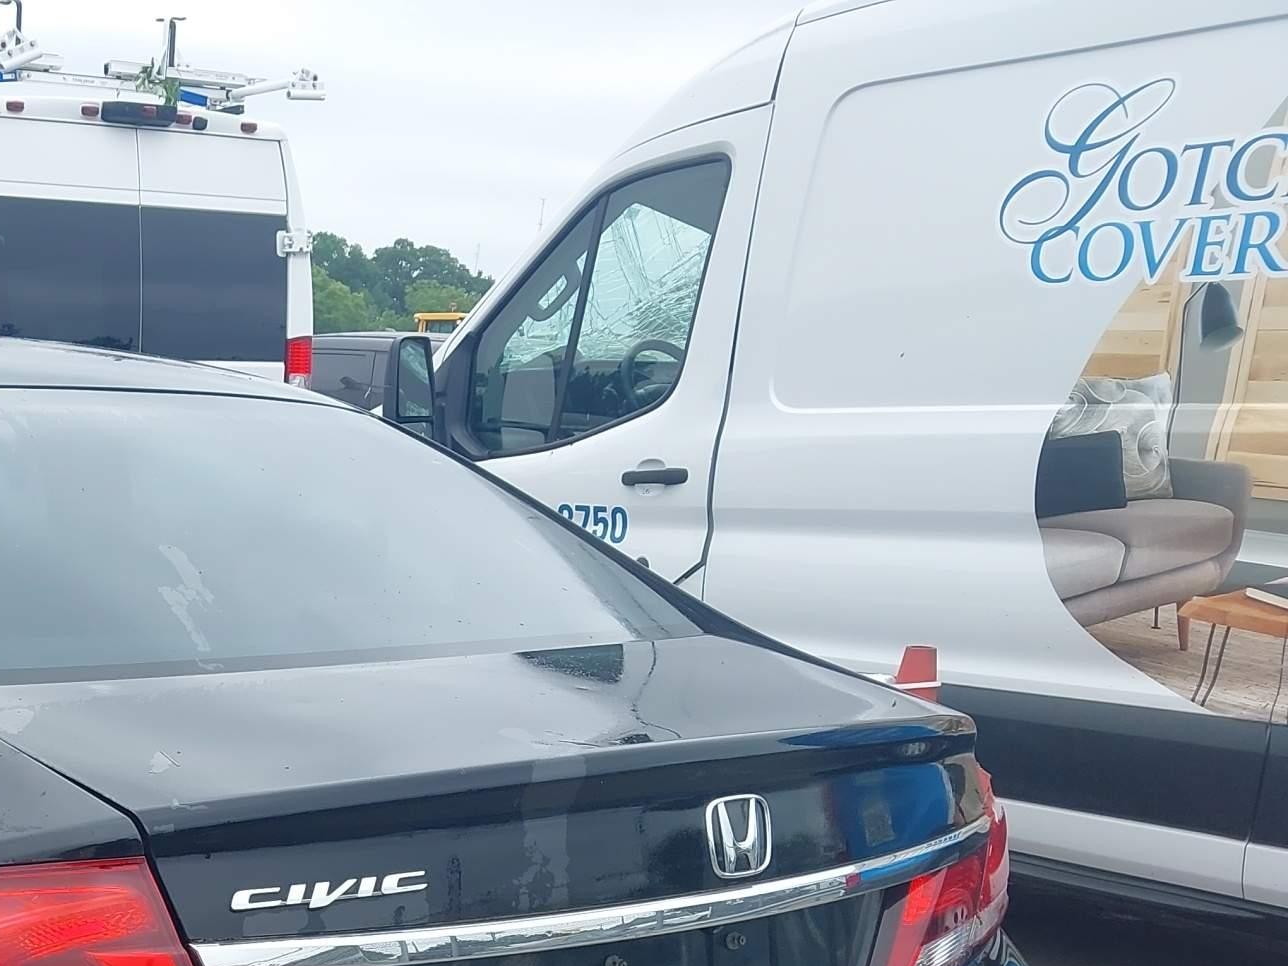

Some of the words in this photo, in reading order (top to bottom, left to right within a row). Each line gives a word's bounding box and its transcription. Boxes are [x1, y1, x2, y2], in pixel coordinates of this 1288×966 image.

[999, 77, 1288, 245] GOTC
[1030, 211, 1288, 284] COVER
[230, 870, 428, 911] CIVIC
